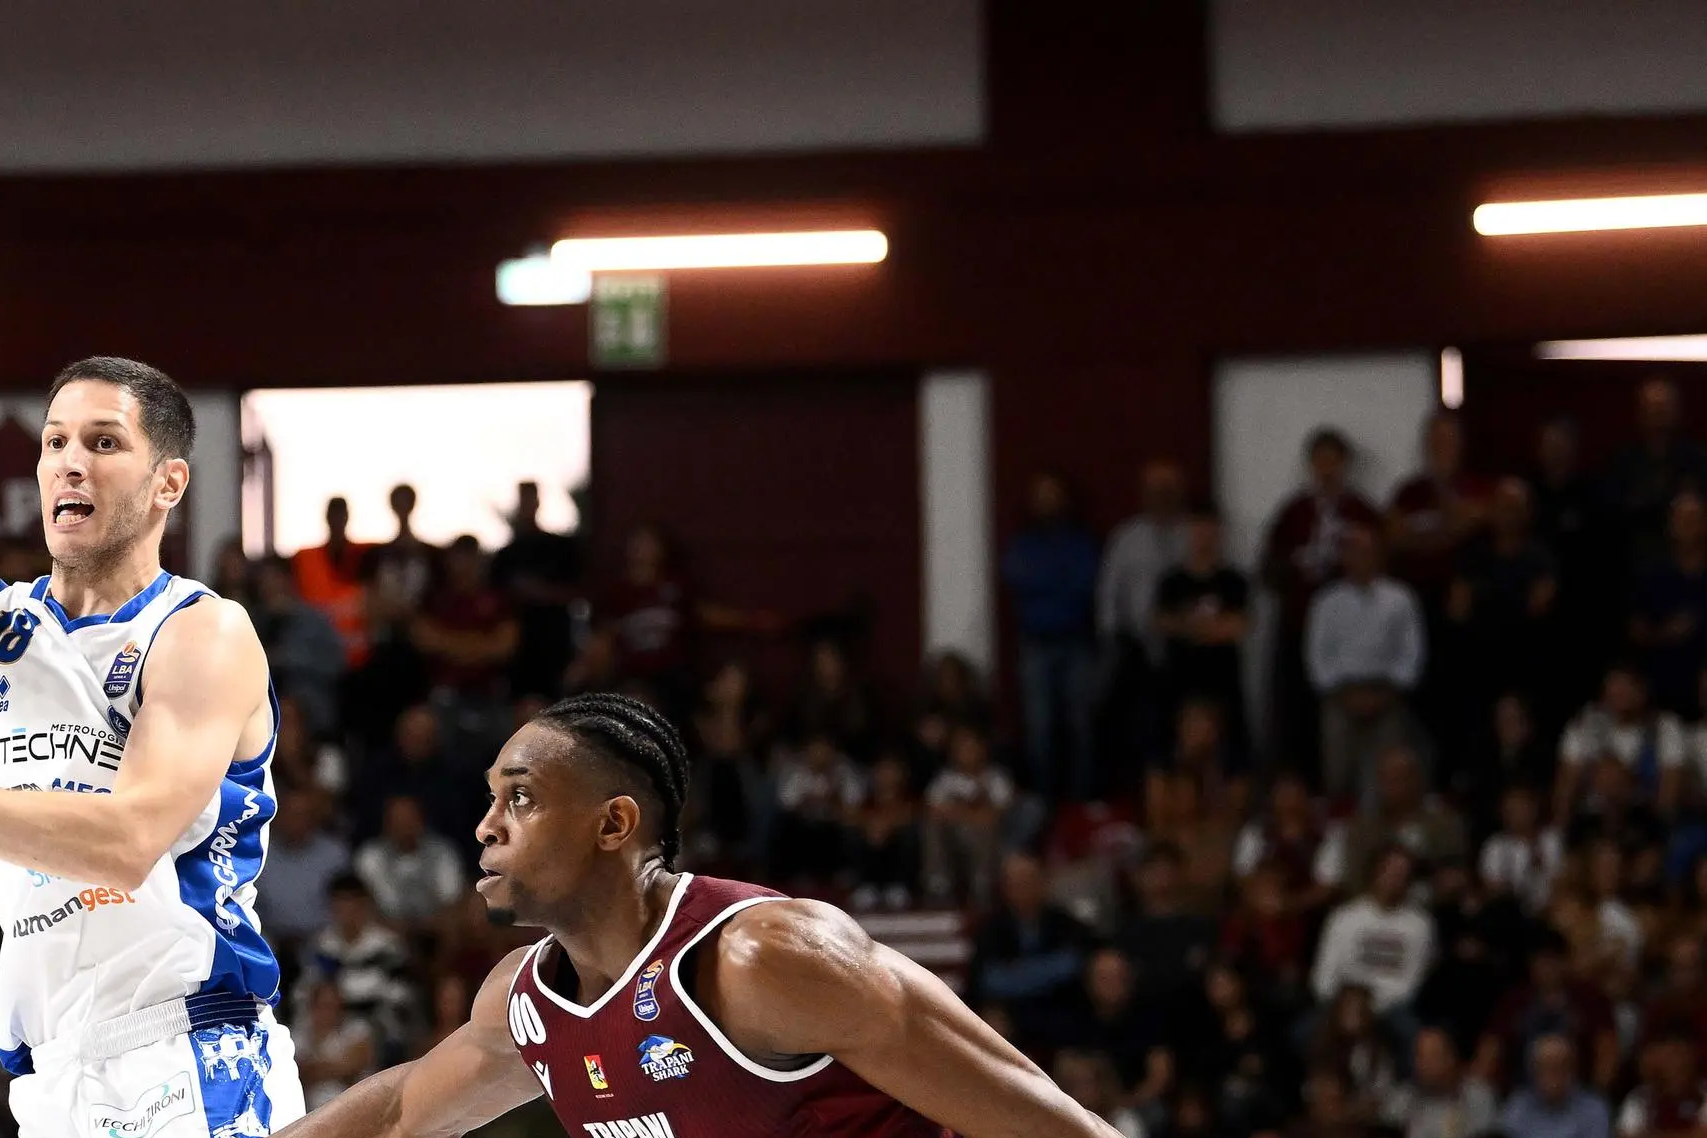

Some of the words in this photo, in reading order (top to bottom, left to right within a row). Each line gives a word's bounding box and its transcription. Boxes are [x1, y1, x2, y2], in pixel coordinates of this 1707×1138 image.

[112, 665, 133, 675] LBA
[50, 723, 124, 747] METROLOGI
[508, 992, 547, 1047] 00
[641, 1050, 695, 1075] TRAPANI
[652, 1064, 690, 1082] SHARK
[93, 1117, 146, 1132] VECCHI
[145, 1087, 185, 1123] ZIRONI
